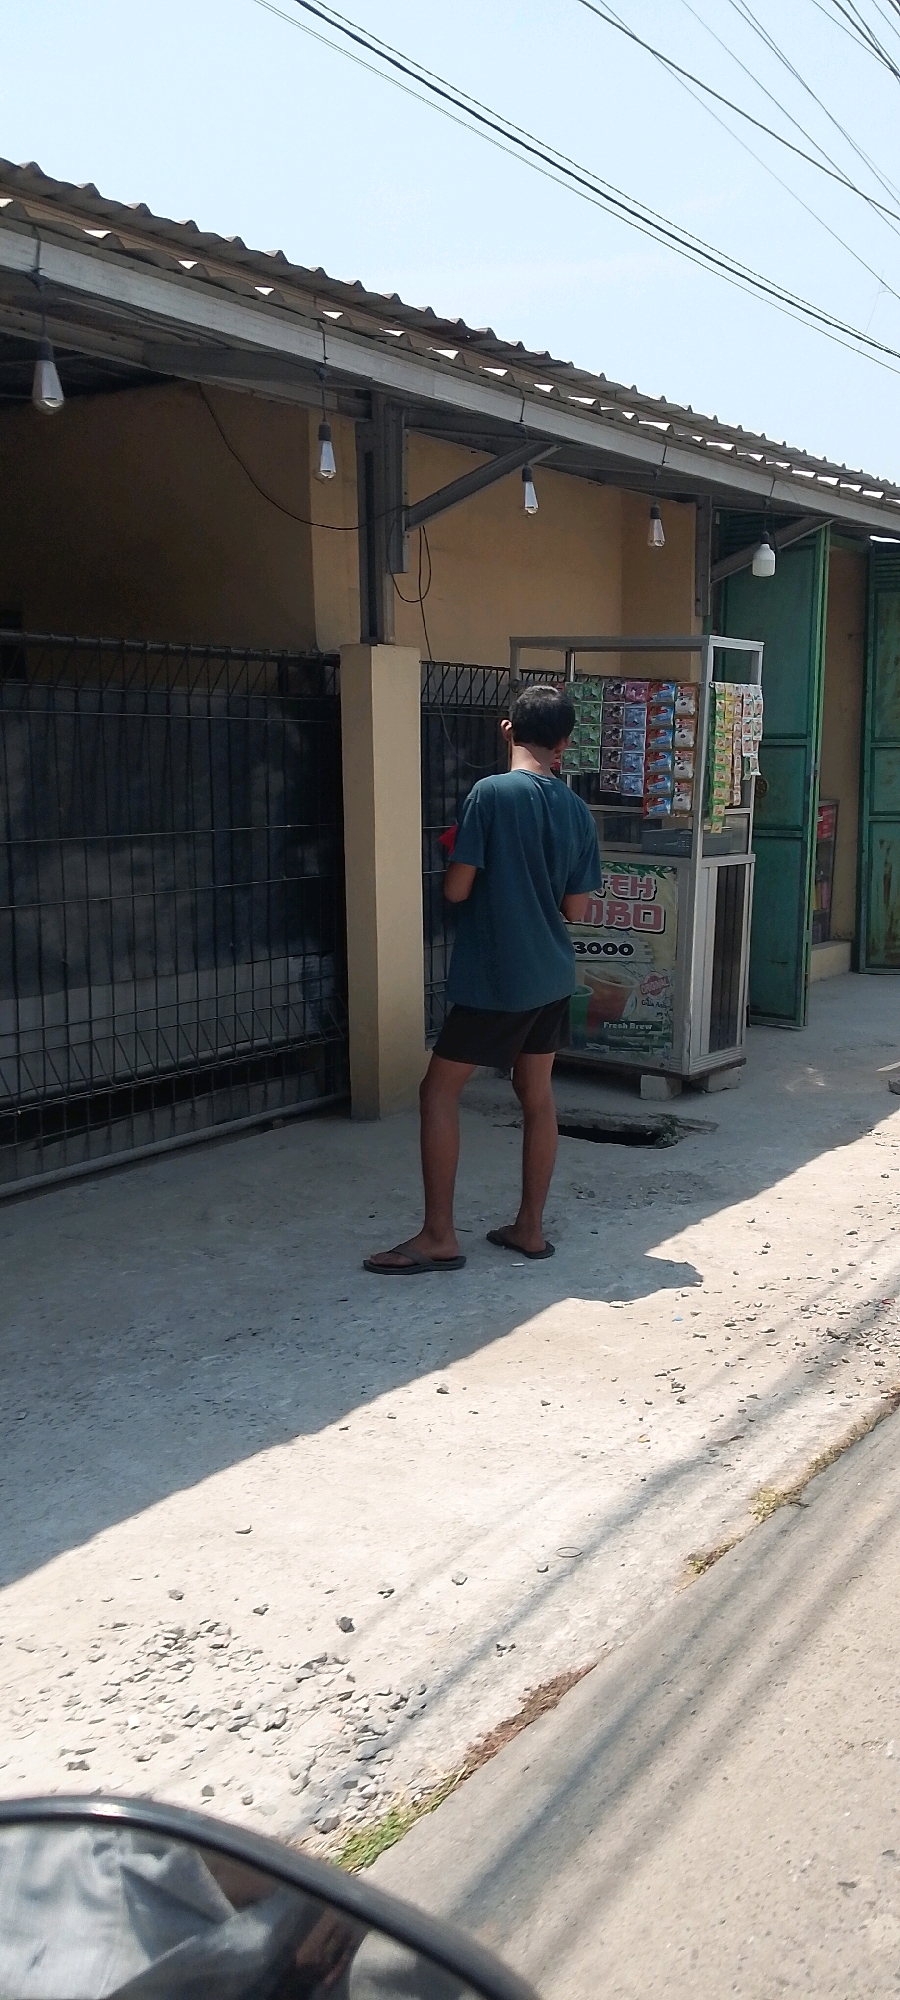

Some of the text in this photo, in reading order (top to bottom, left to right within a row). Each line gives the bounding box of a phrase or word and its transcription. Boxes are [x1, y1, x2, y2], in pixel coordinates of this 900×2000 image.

[571, 899, 666, 933] MBO
[573, 942, 634, 956] 3000
[603, 1021, 653, 1030] Fresh Brew
